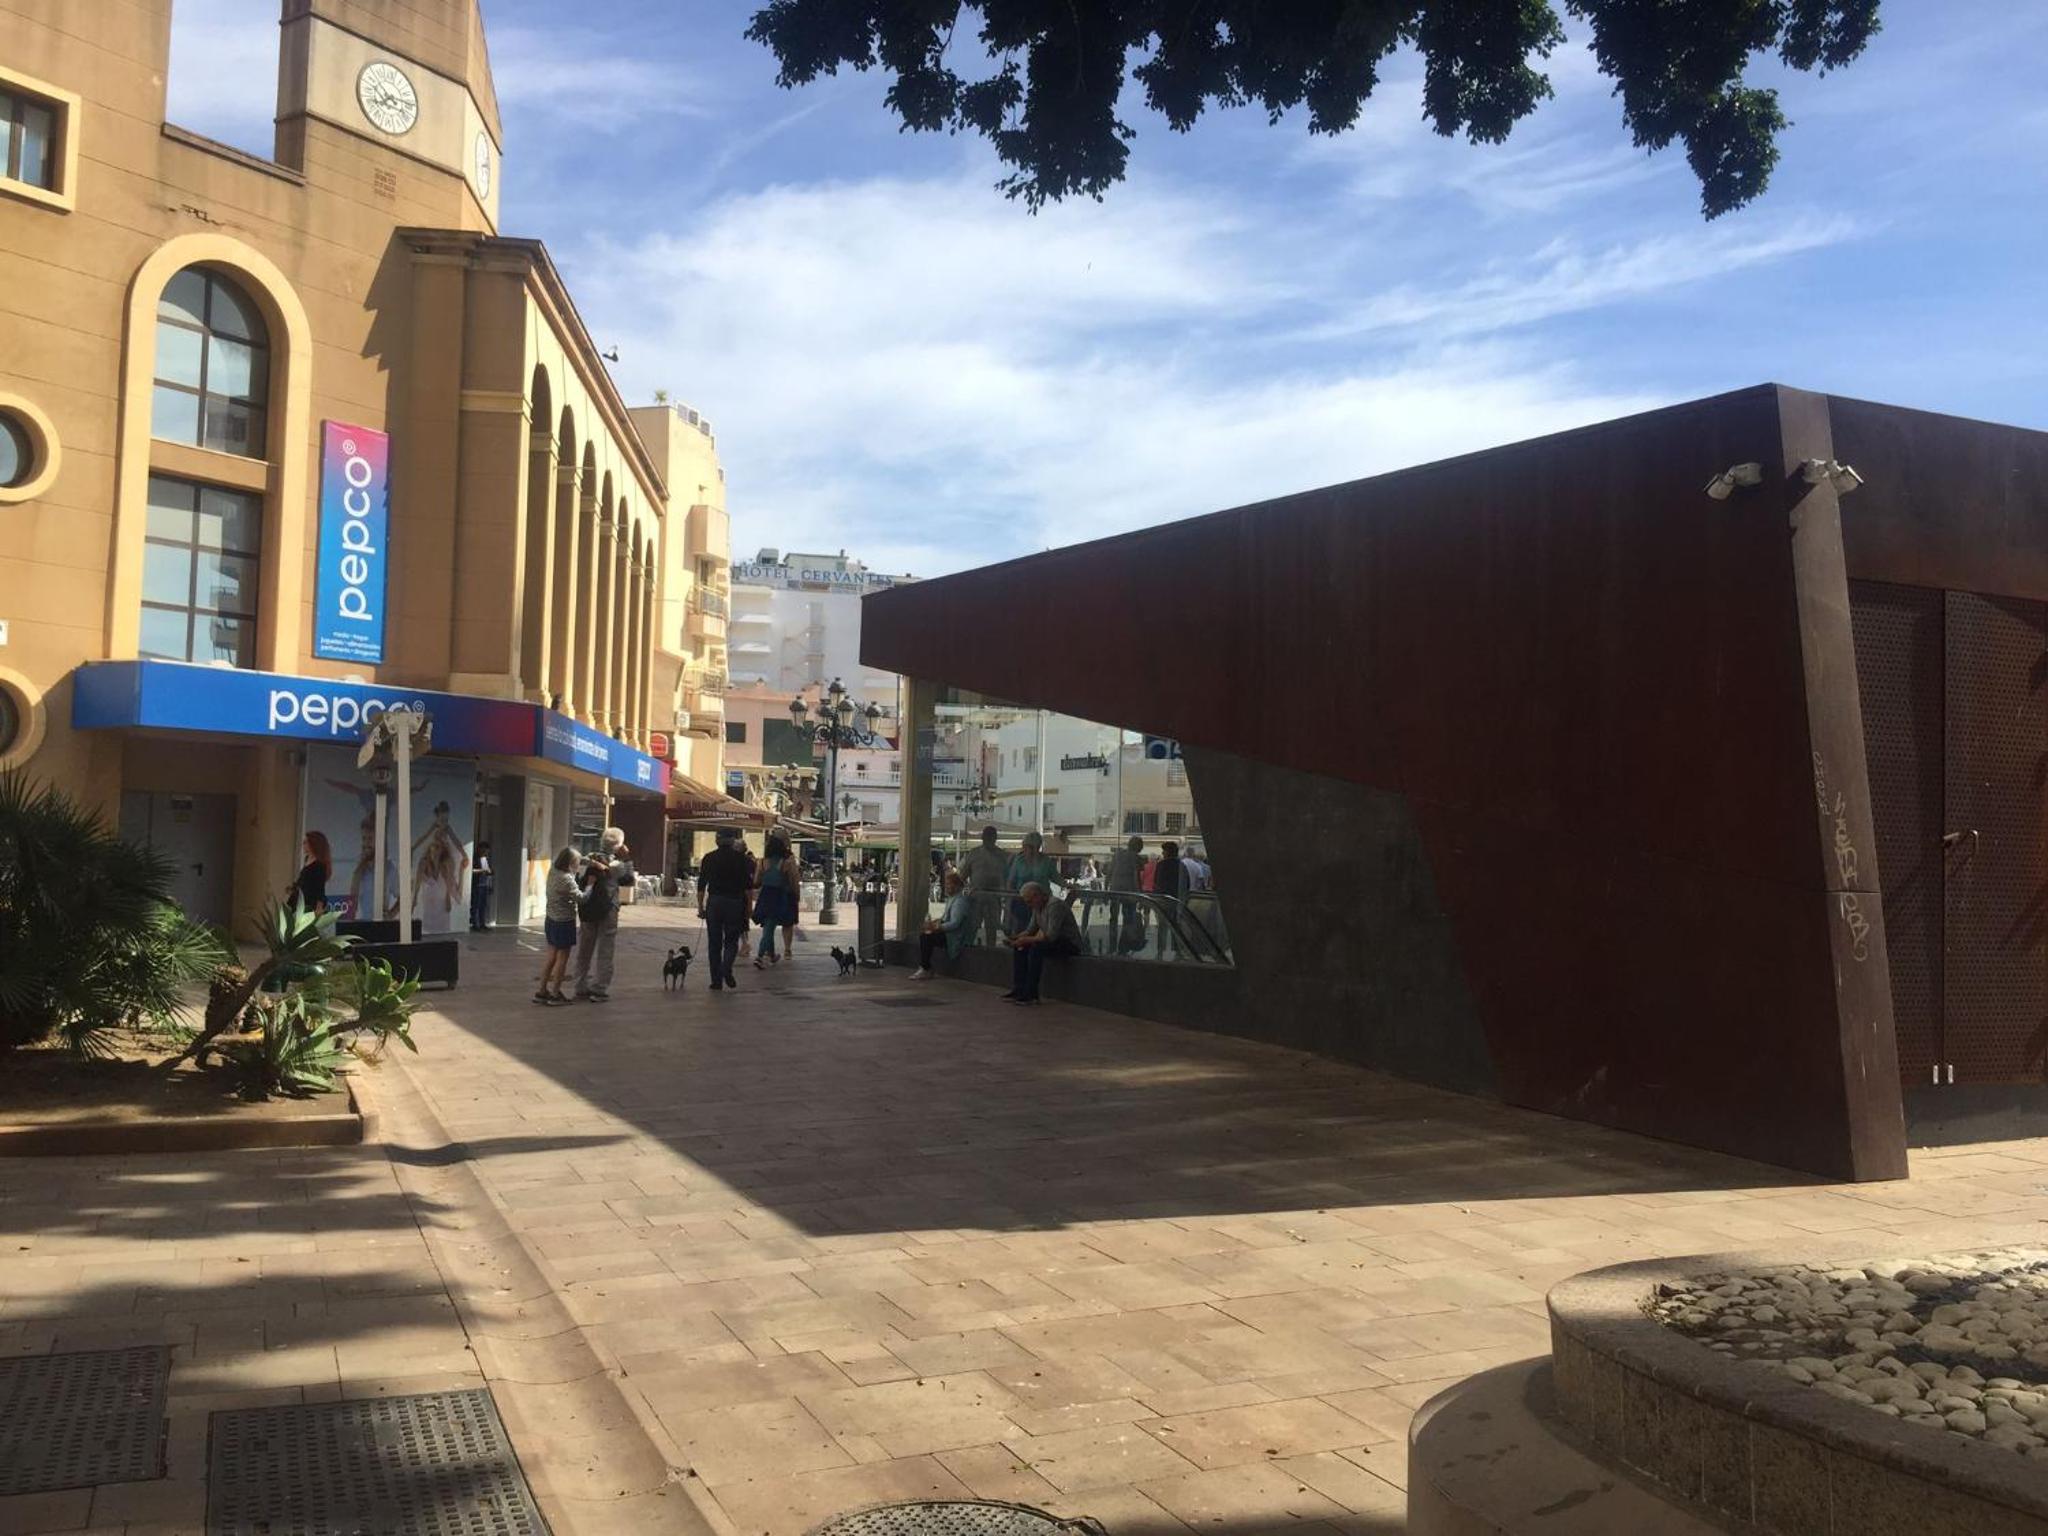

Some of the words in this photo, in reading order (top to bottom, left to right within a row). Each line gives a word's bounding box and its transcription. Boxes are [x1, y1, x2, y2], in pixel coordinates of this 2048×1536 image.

[339, 456, 376, 621] pepco
[740, 565, 793, 580] HOTEL
[800, 568, 893, 585] CERVANTES
